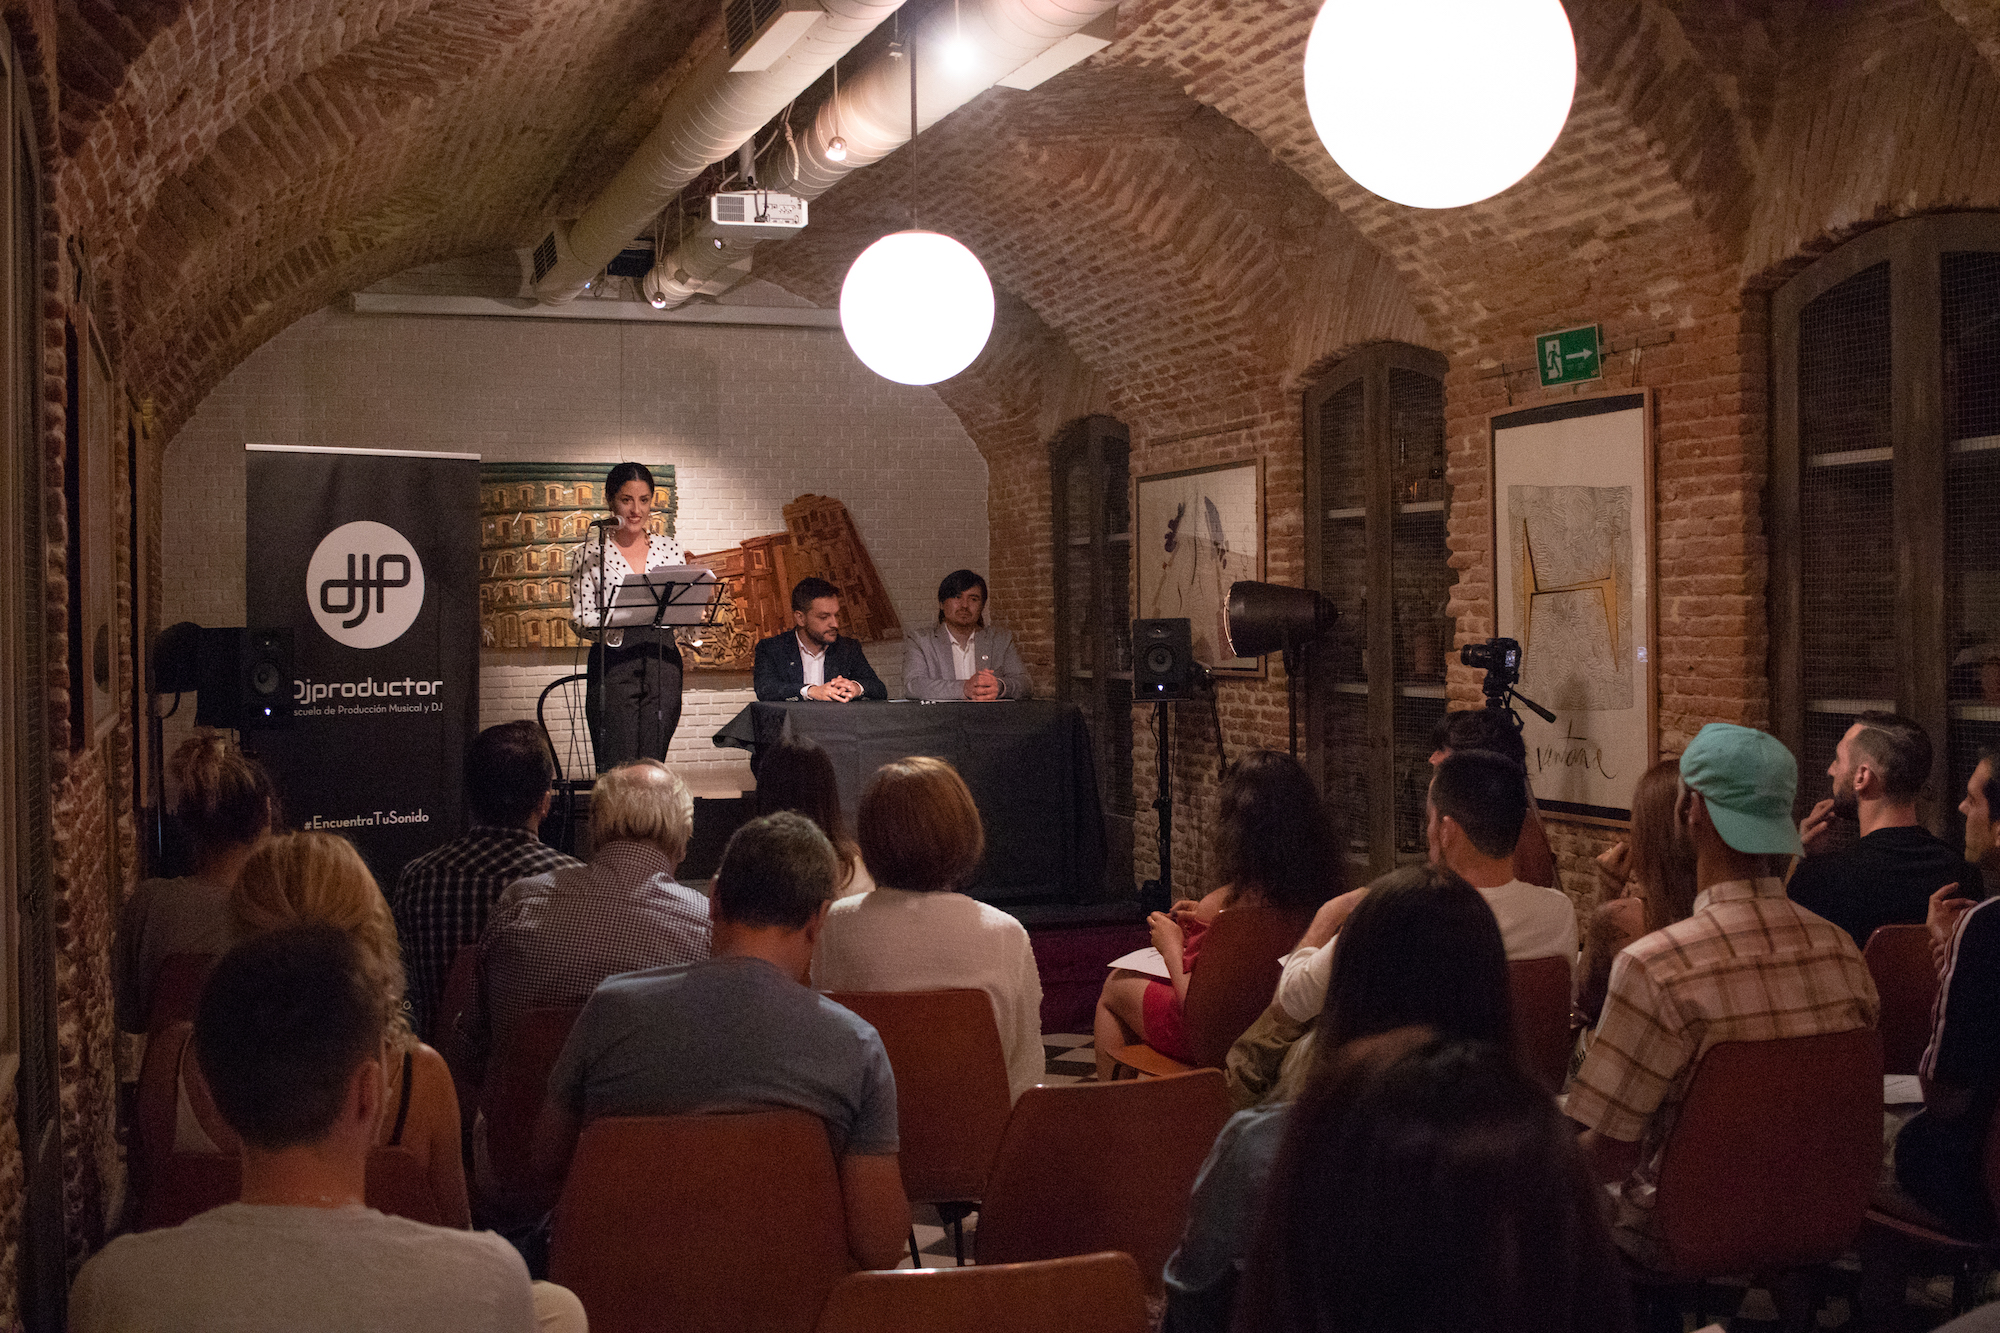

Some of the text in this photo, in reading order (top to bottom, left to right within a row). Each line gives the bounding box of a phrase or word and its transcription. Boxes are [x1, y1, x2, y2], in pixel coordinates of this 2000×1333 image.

[293, 702, 444, 717] scuela de Producción Musical y DJ
[305, 808, 429, 830] #EncuentraTuSonido
